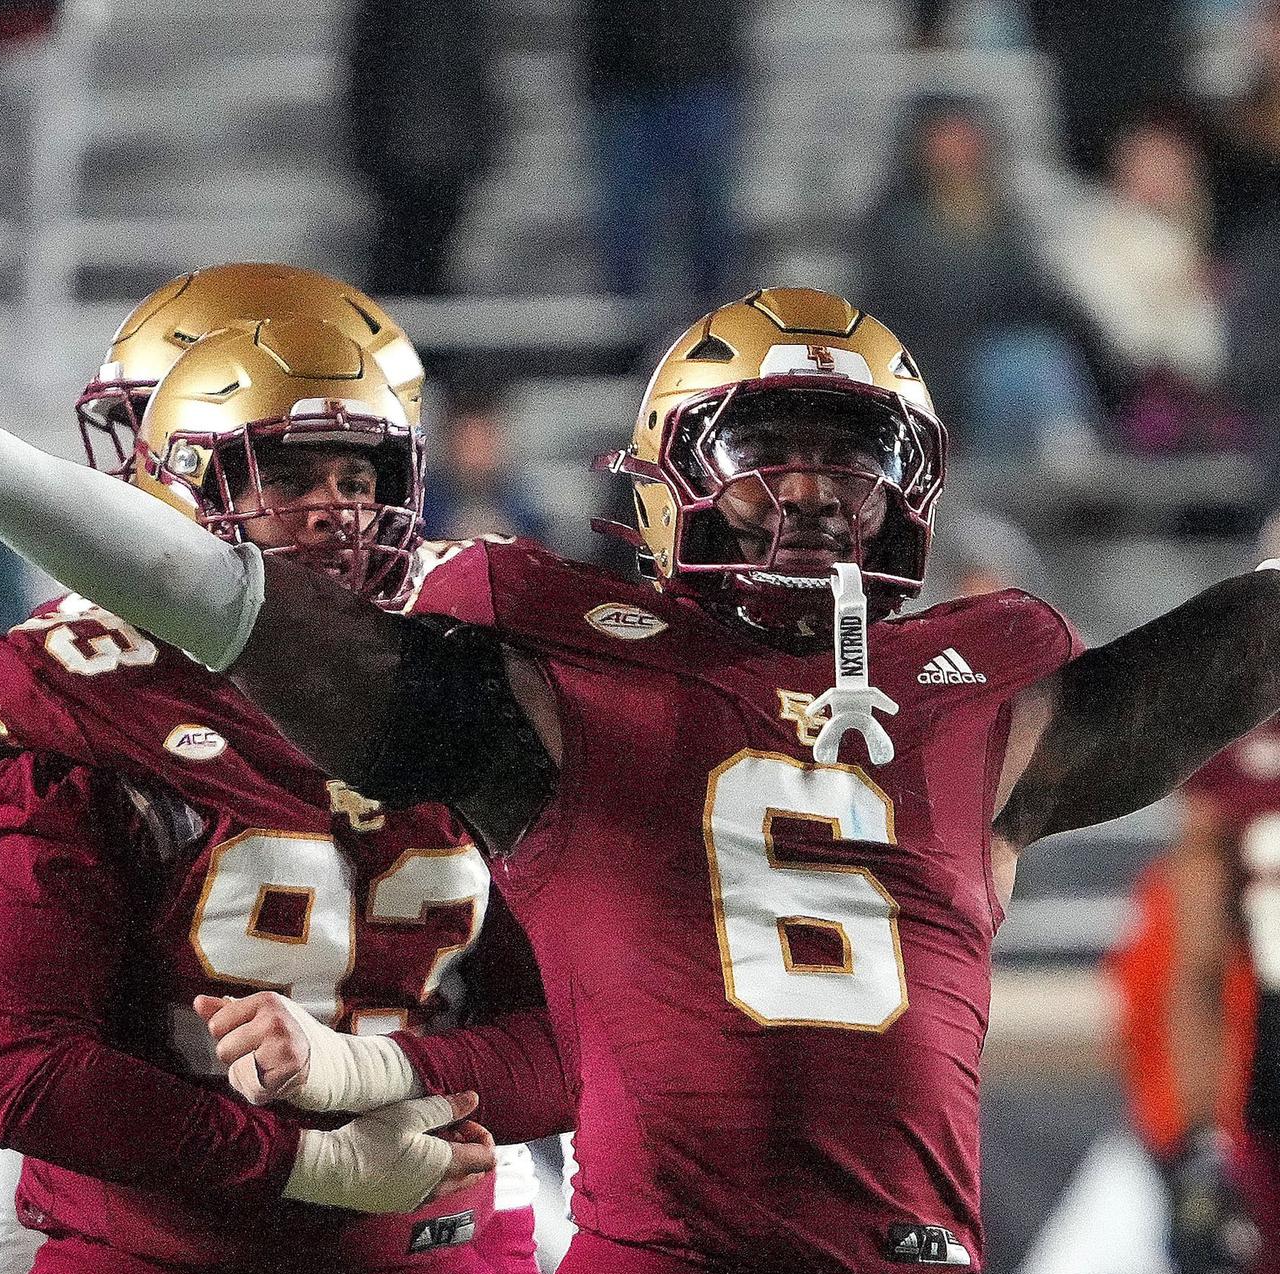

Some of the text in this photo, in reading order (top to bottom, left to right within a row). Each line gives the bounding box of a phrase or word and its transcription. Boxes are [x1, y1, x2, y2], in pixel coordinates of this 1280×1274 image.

[599, 611, 655, 626] ACC
[840, 615, 864, 677] NXTRND
[917, 670, 988, 685] adidas
[176, 731, 219, 748] ACC
[702, 747, 909, 1034] 6
